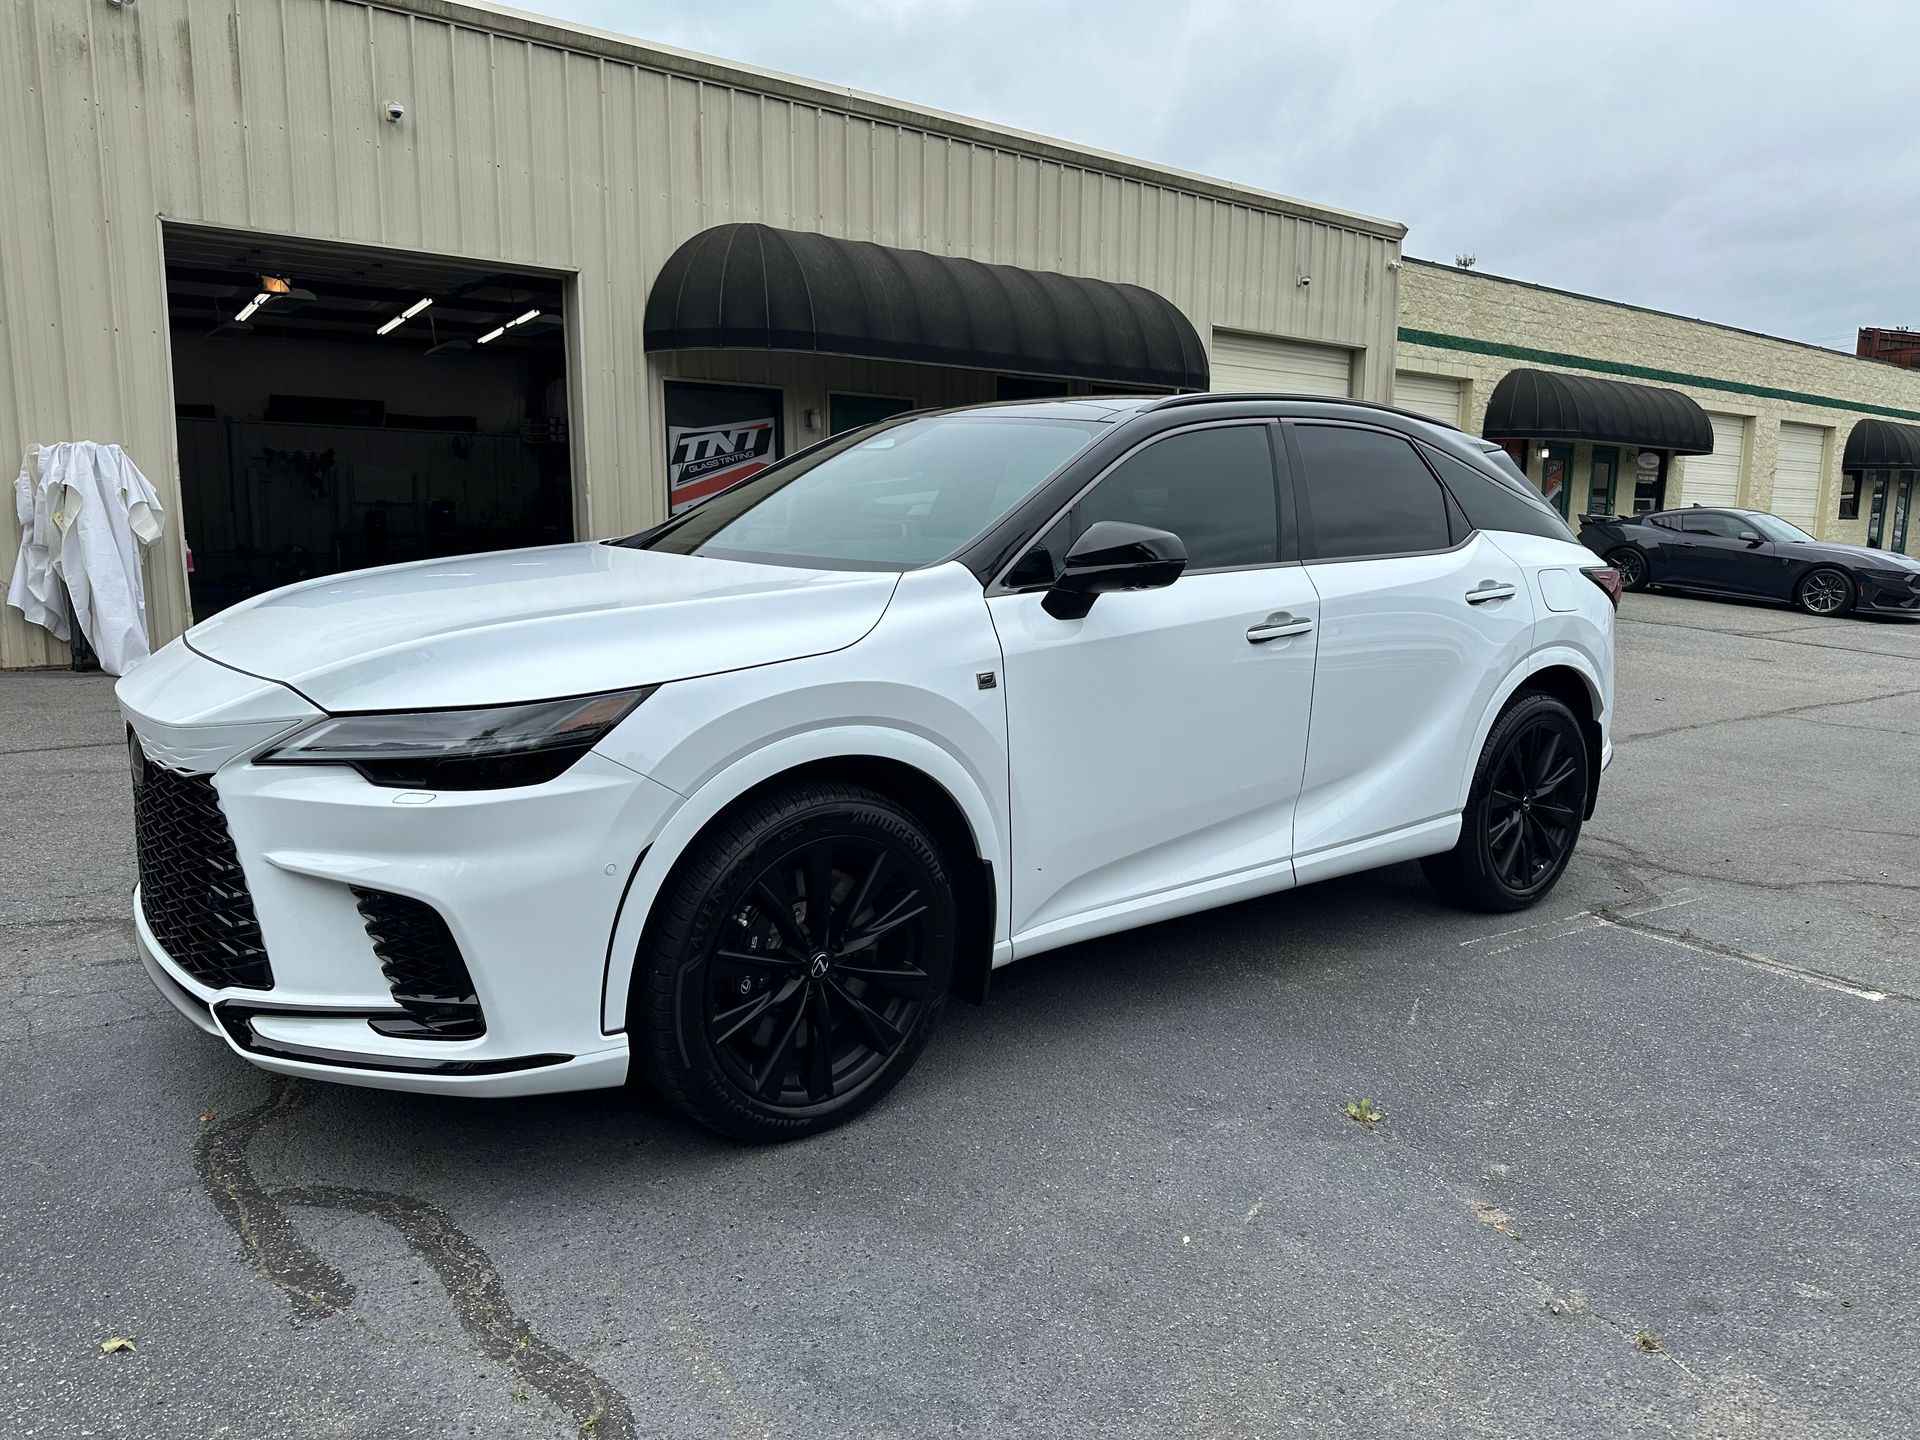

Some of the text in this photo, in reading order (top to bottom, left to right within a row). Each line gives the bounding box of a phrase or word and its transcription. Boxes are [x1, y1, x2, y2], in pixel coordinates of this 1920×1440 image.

[679, 430, 759, 461] TNT
[688, 450, 755, 473] GLASS TINTING
[850, 809, 945, 882] BRIDGESTONE
